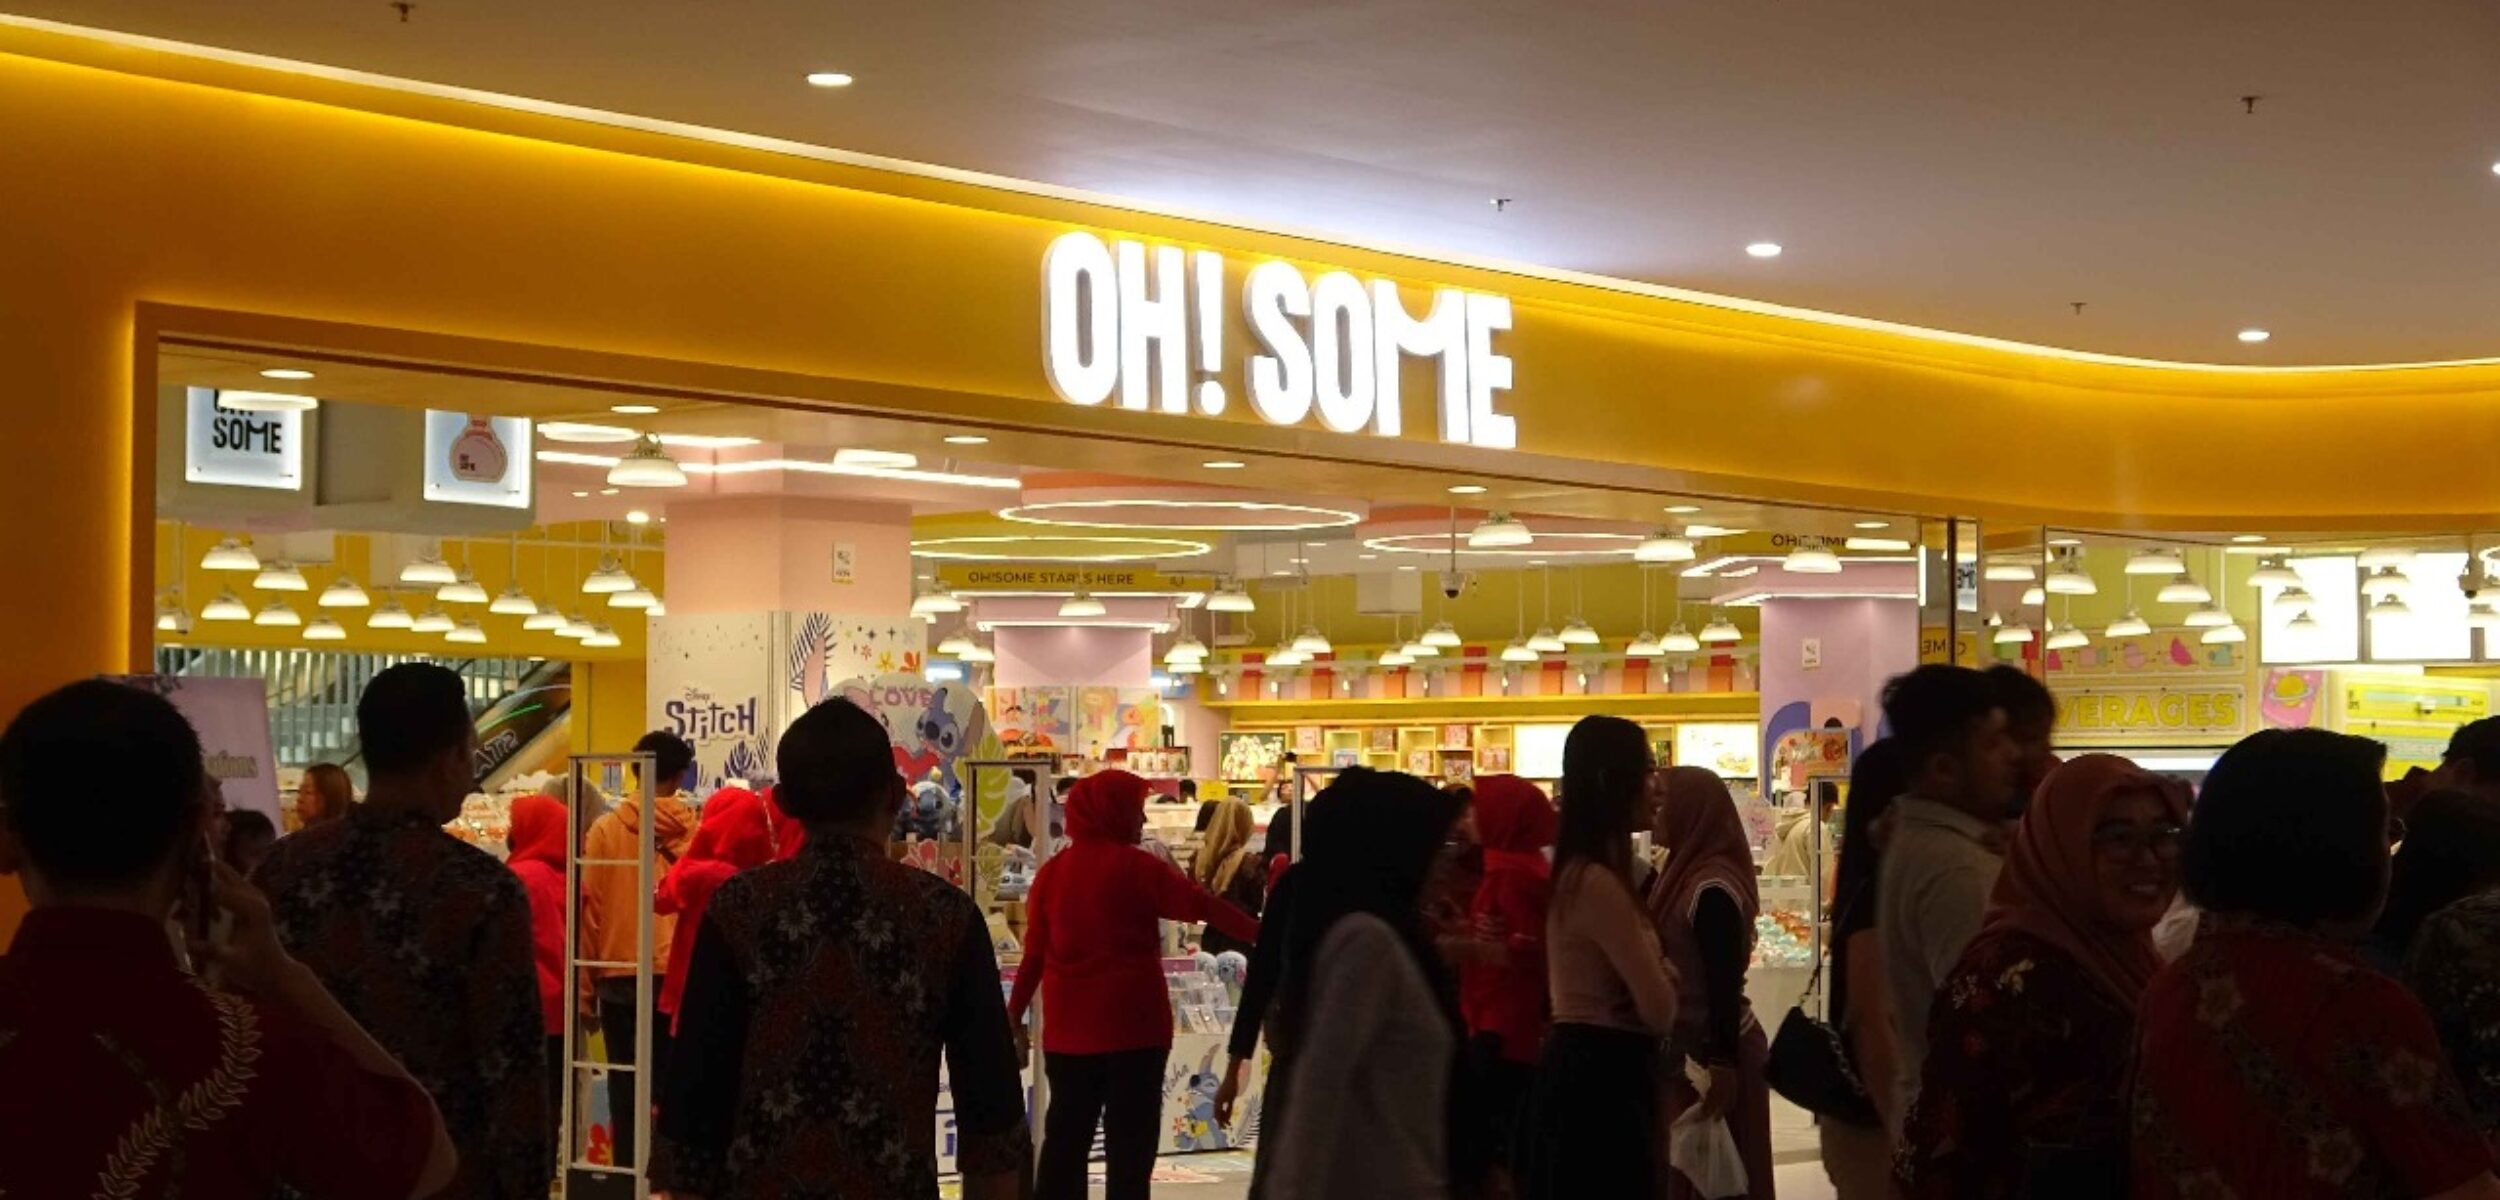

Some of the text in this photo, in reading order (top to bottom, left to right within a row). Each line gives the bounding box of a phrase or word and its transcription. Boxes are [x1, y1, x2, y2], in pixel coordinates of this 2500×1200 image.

[1041, 231, 1517, 449] OH! SOME
[213, 417, 282, 454] SOME
[1097, 573, 1135, 585] HERE
[869, 686, 933, 707] LOVE
